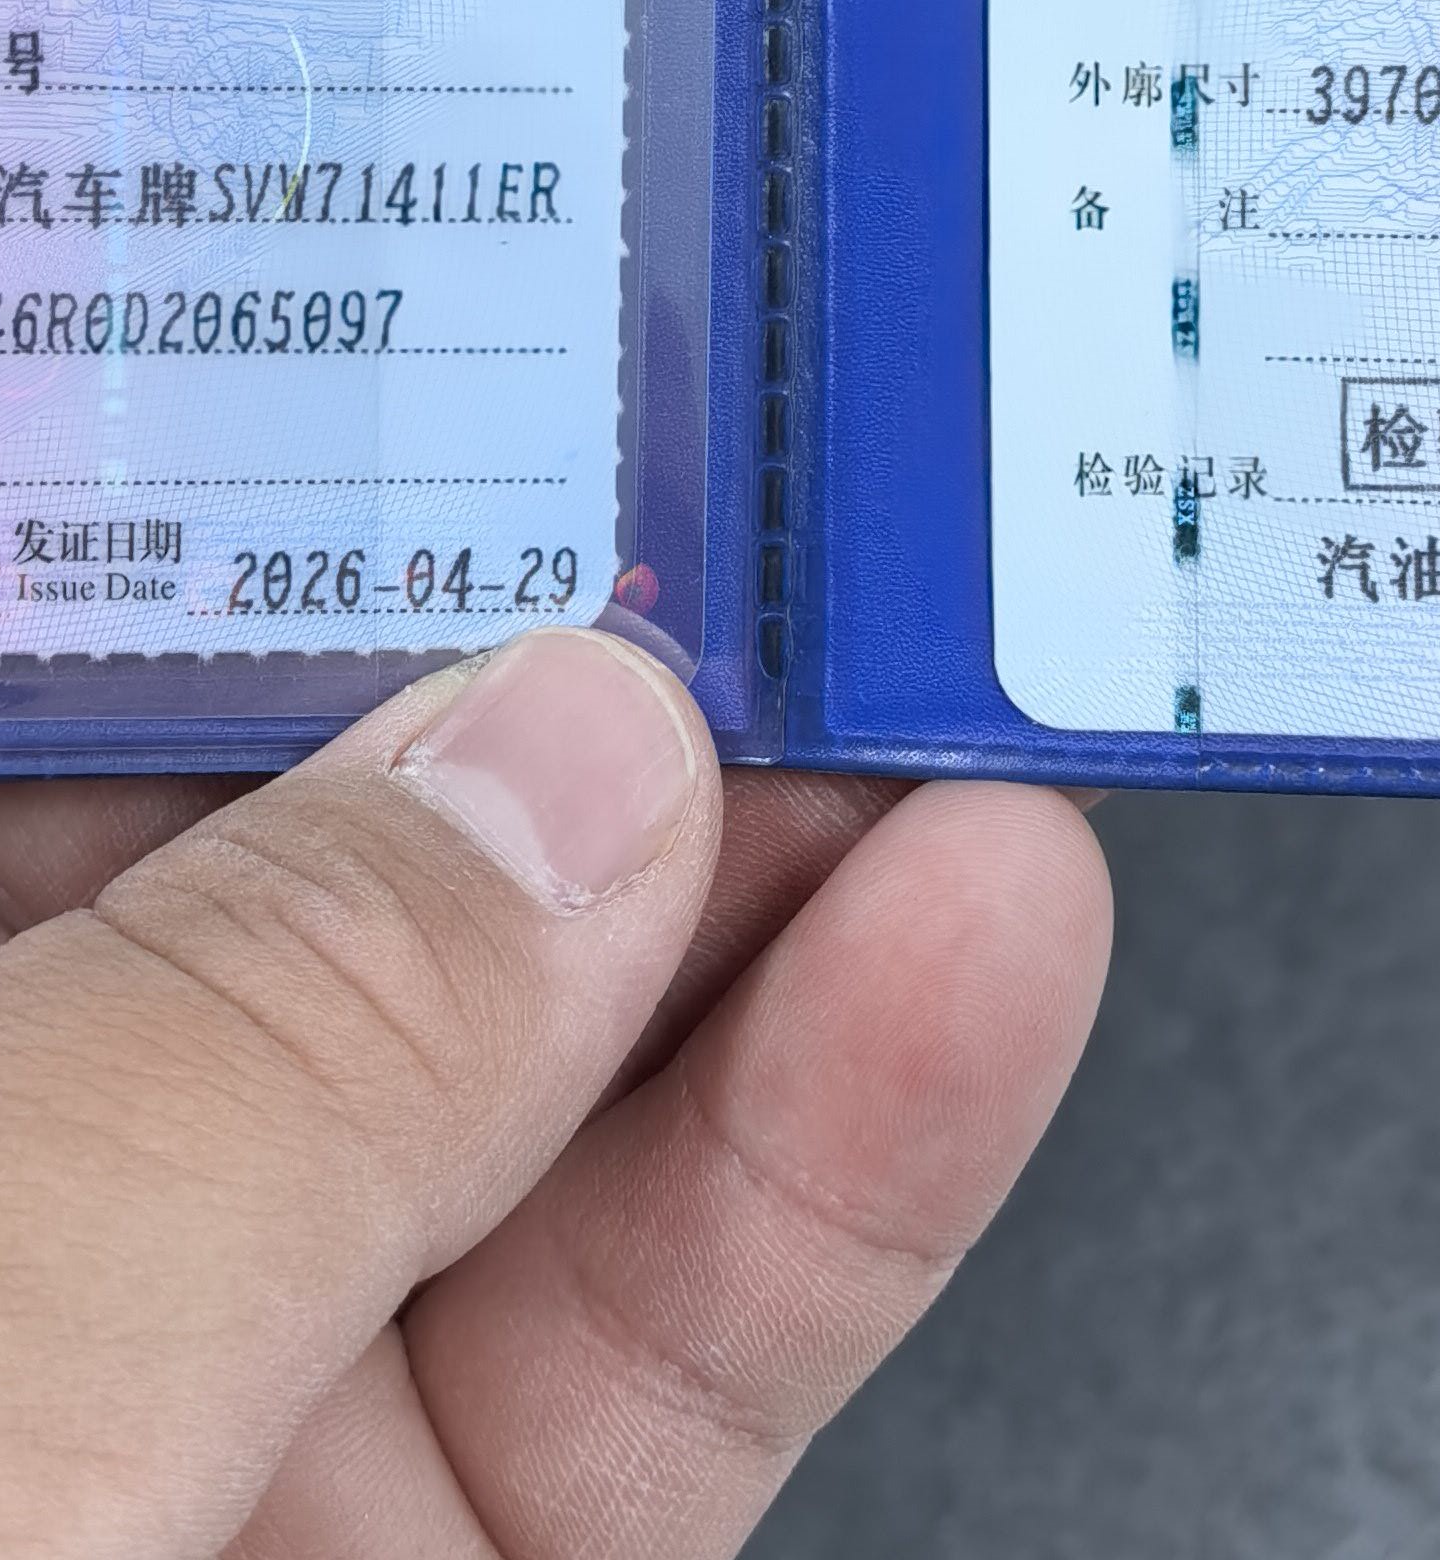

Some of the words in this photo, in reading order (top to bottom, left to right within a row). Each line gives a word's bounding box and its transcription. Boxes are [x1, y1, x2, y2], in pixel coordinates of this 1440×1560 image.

[1068, 62, 1259, 110] 外廓尺寸
[1073, 450, 1269, 501] 检验记录
[14, 518, 183, 566] 发证日期
[16, 571, 98, 604] Issue
[106, 572, 177, 604] Date
[229, 547, 579, 614] 2026-04-29
